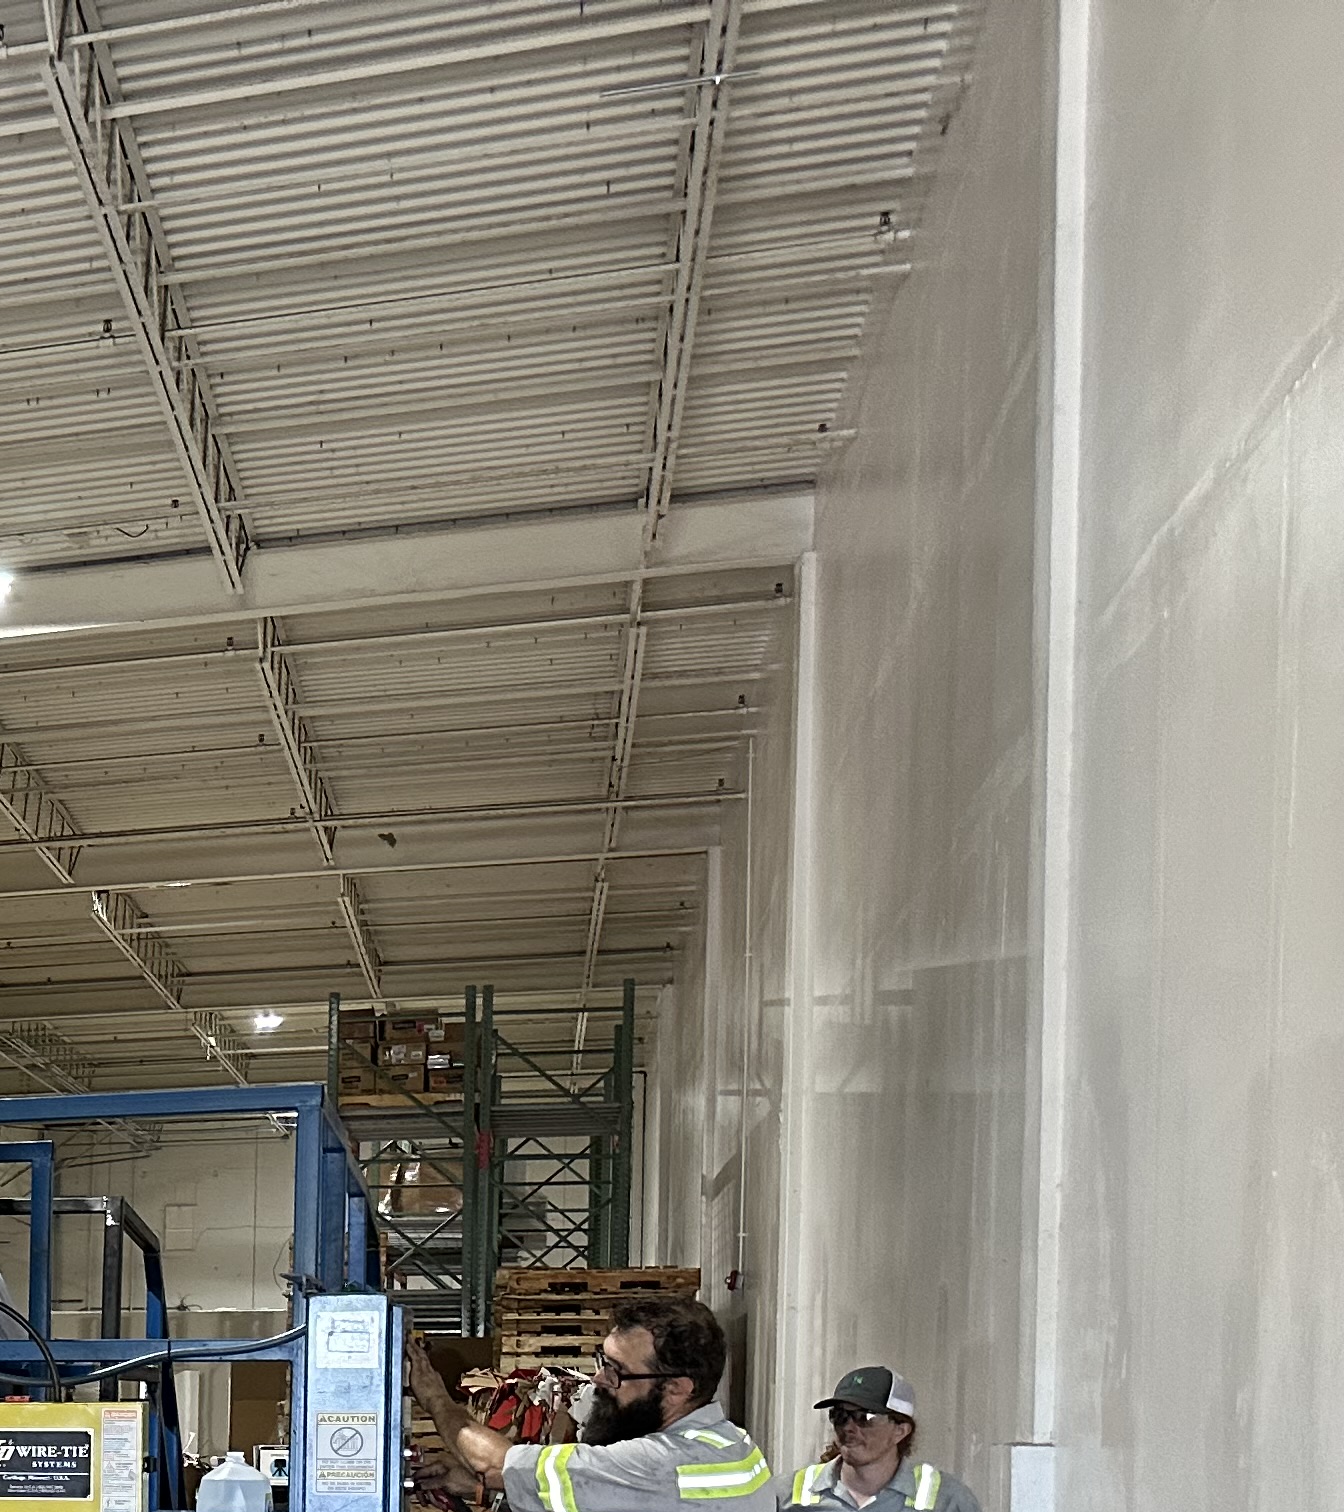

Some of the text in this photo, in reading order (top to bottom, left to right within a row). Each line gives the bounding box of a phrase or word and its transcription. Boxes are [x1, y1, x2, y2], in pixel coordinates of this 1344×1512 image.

[327, 1415, 376, 1423] CAUTION
[16, 1445, 88, 1458] WIRE-TIE
[327, 1471, 375, 1479] PRECAUCIÓN
